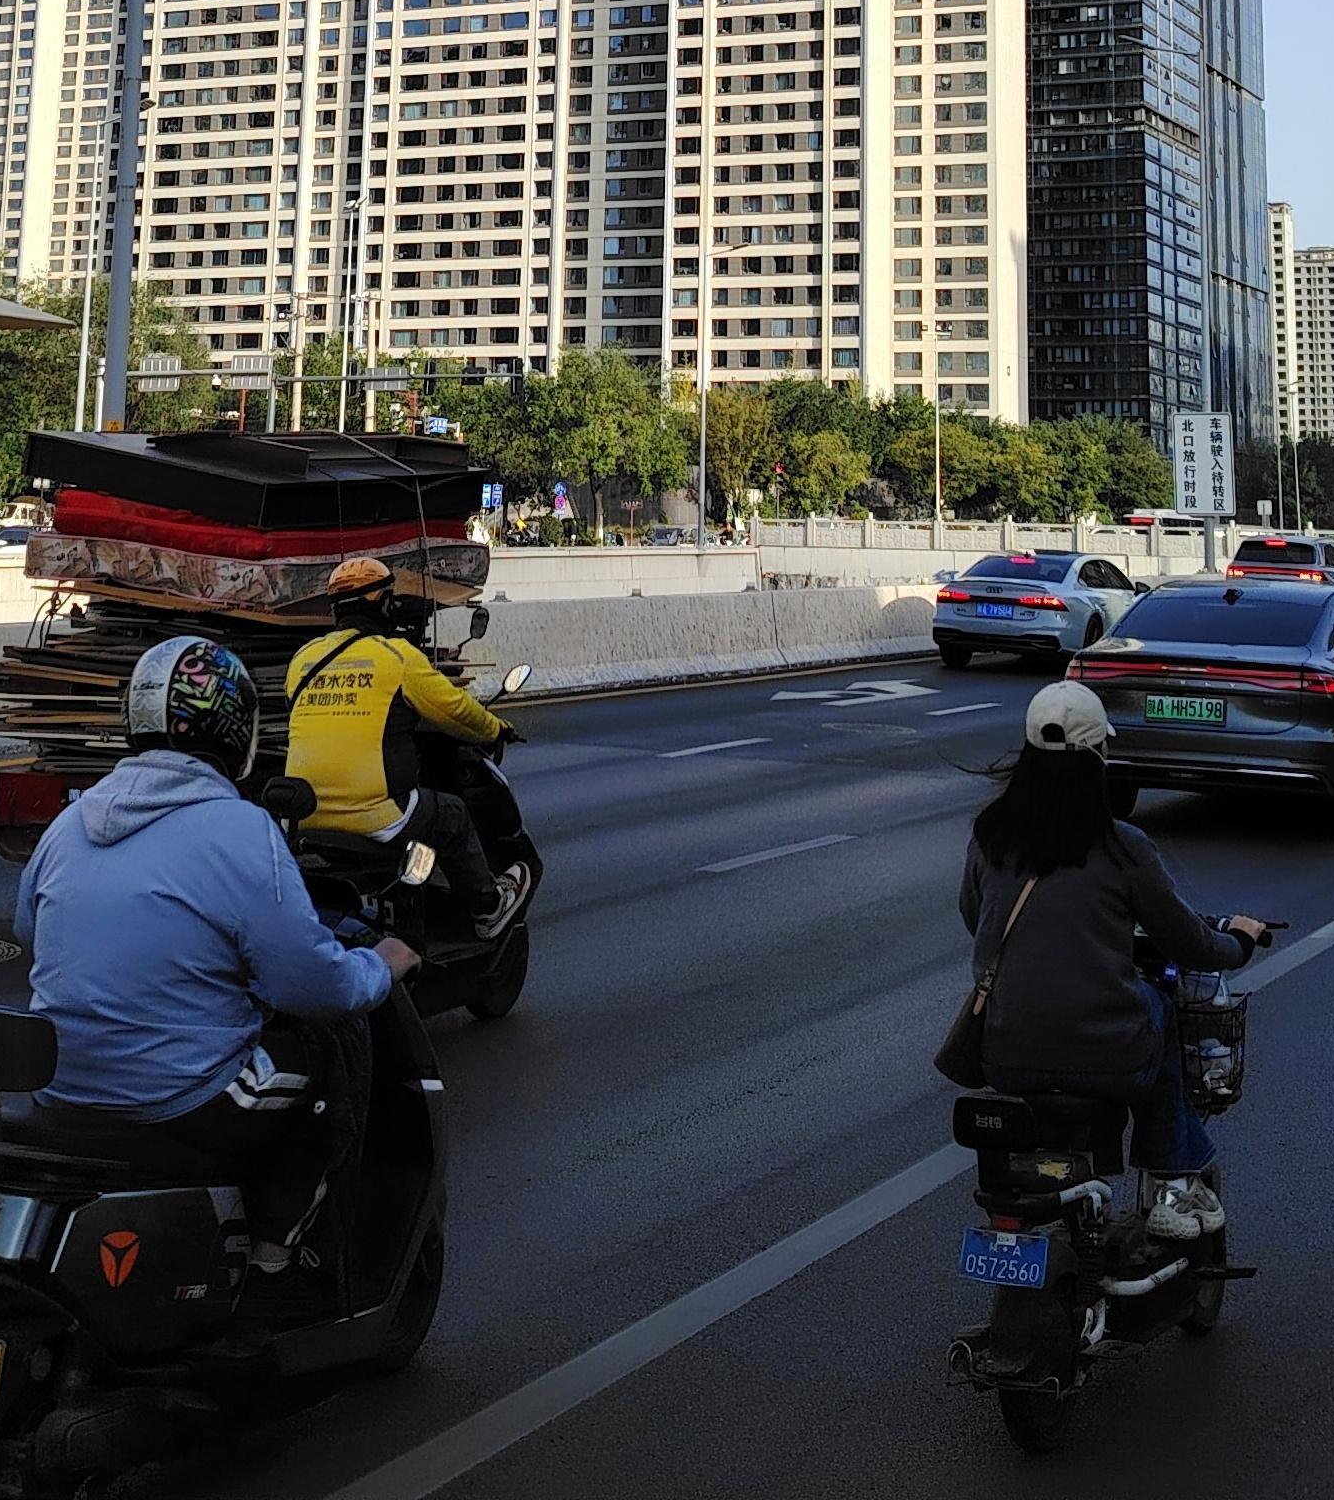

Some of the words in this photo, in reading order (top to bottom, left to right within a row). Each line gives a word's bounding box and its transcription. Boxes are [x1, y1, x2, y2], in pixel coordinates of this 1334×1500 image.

[1181, 418, 1198, 509] 北口放行时段
[1209, 417, 1226, 511] 车辆驶入待转区
[300, 672, 374, 691] 酒水冷饮
[965, 1253, 1041, 1283] 0572560
